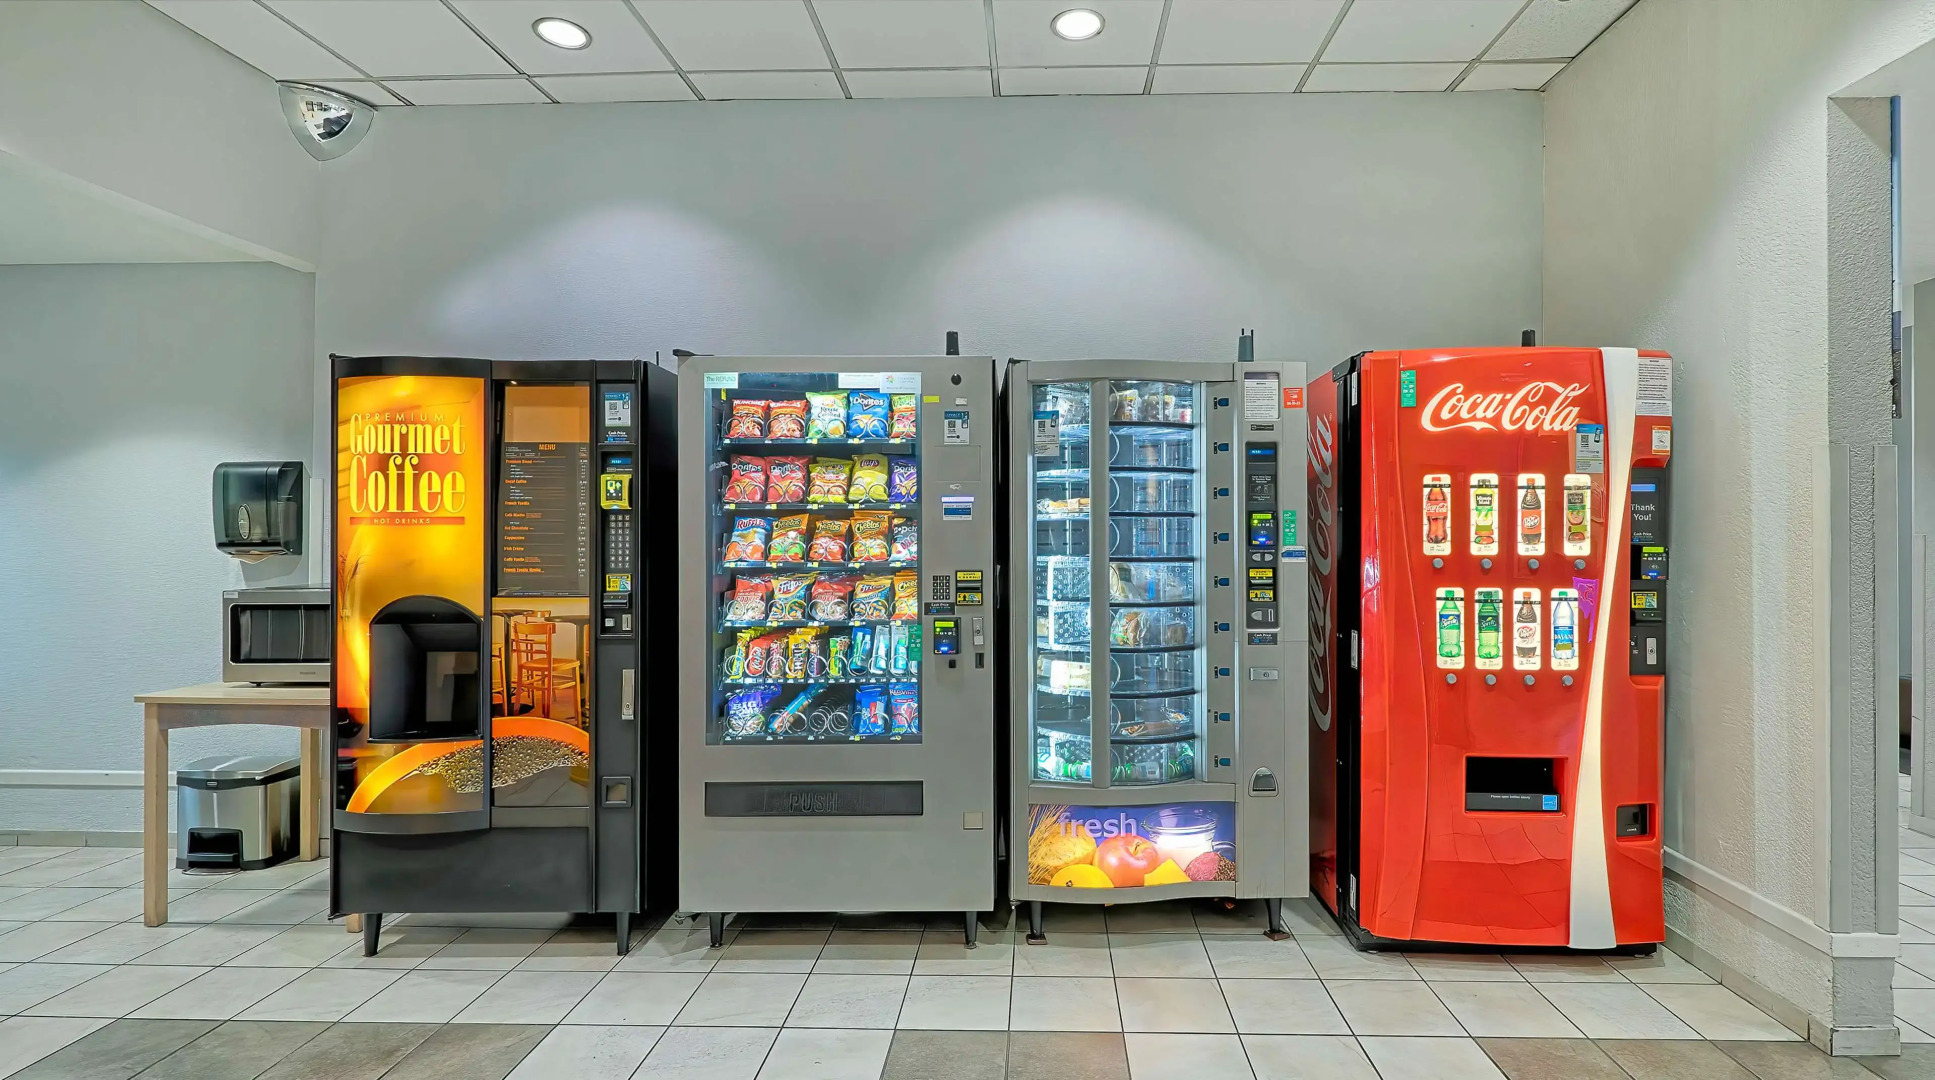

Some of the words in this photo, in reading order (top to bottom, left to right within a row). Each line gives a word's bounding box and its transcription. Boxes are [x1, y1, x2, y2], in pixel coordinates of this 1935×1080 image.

[854, 396, 885, 406] Doritos
[1421, 382, 1590, 432] Coca-Cola
[366, 413, 444, 421] PREMIUM
[350, 414, 466, 454] Gourmet
[732, 462, 762, 471] Doritos
[771, 464, 800, 473] Doritos
[350, 454, 466, 513] Coffee
[736, 518, 766, 529] RUFFLES
[773, 518, 802, 529] Cheetos
[854, 521, 882, 534] Cheetos
[778, 580, 803, 593] Fritos
[1441, 616, 1458, 628] Sprite
[789, 792, 838, 812] PUSH
[1058, 812, 1137, 838] fresh
